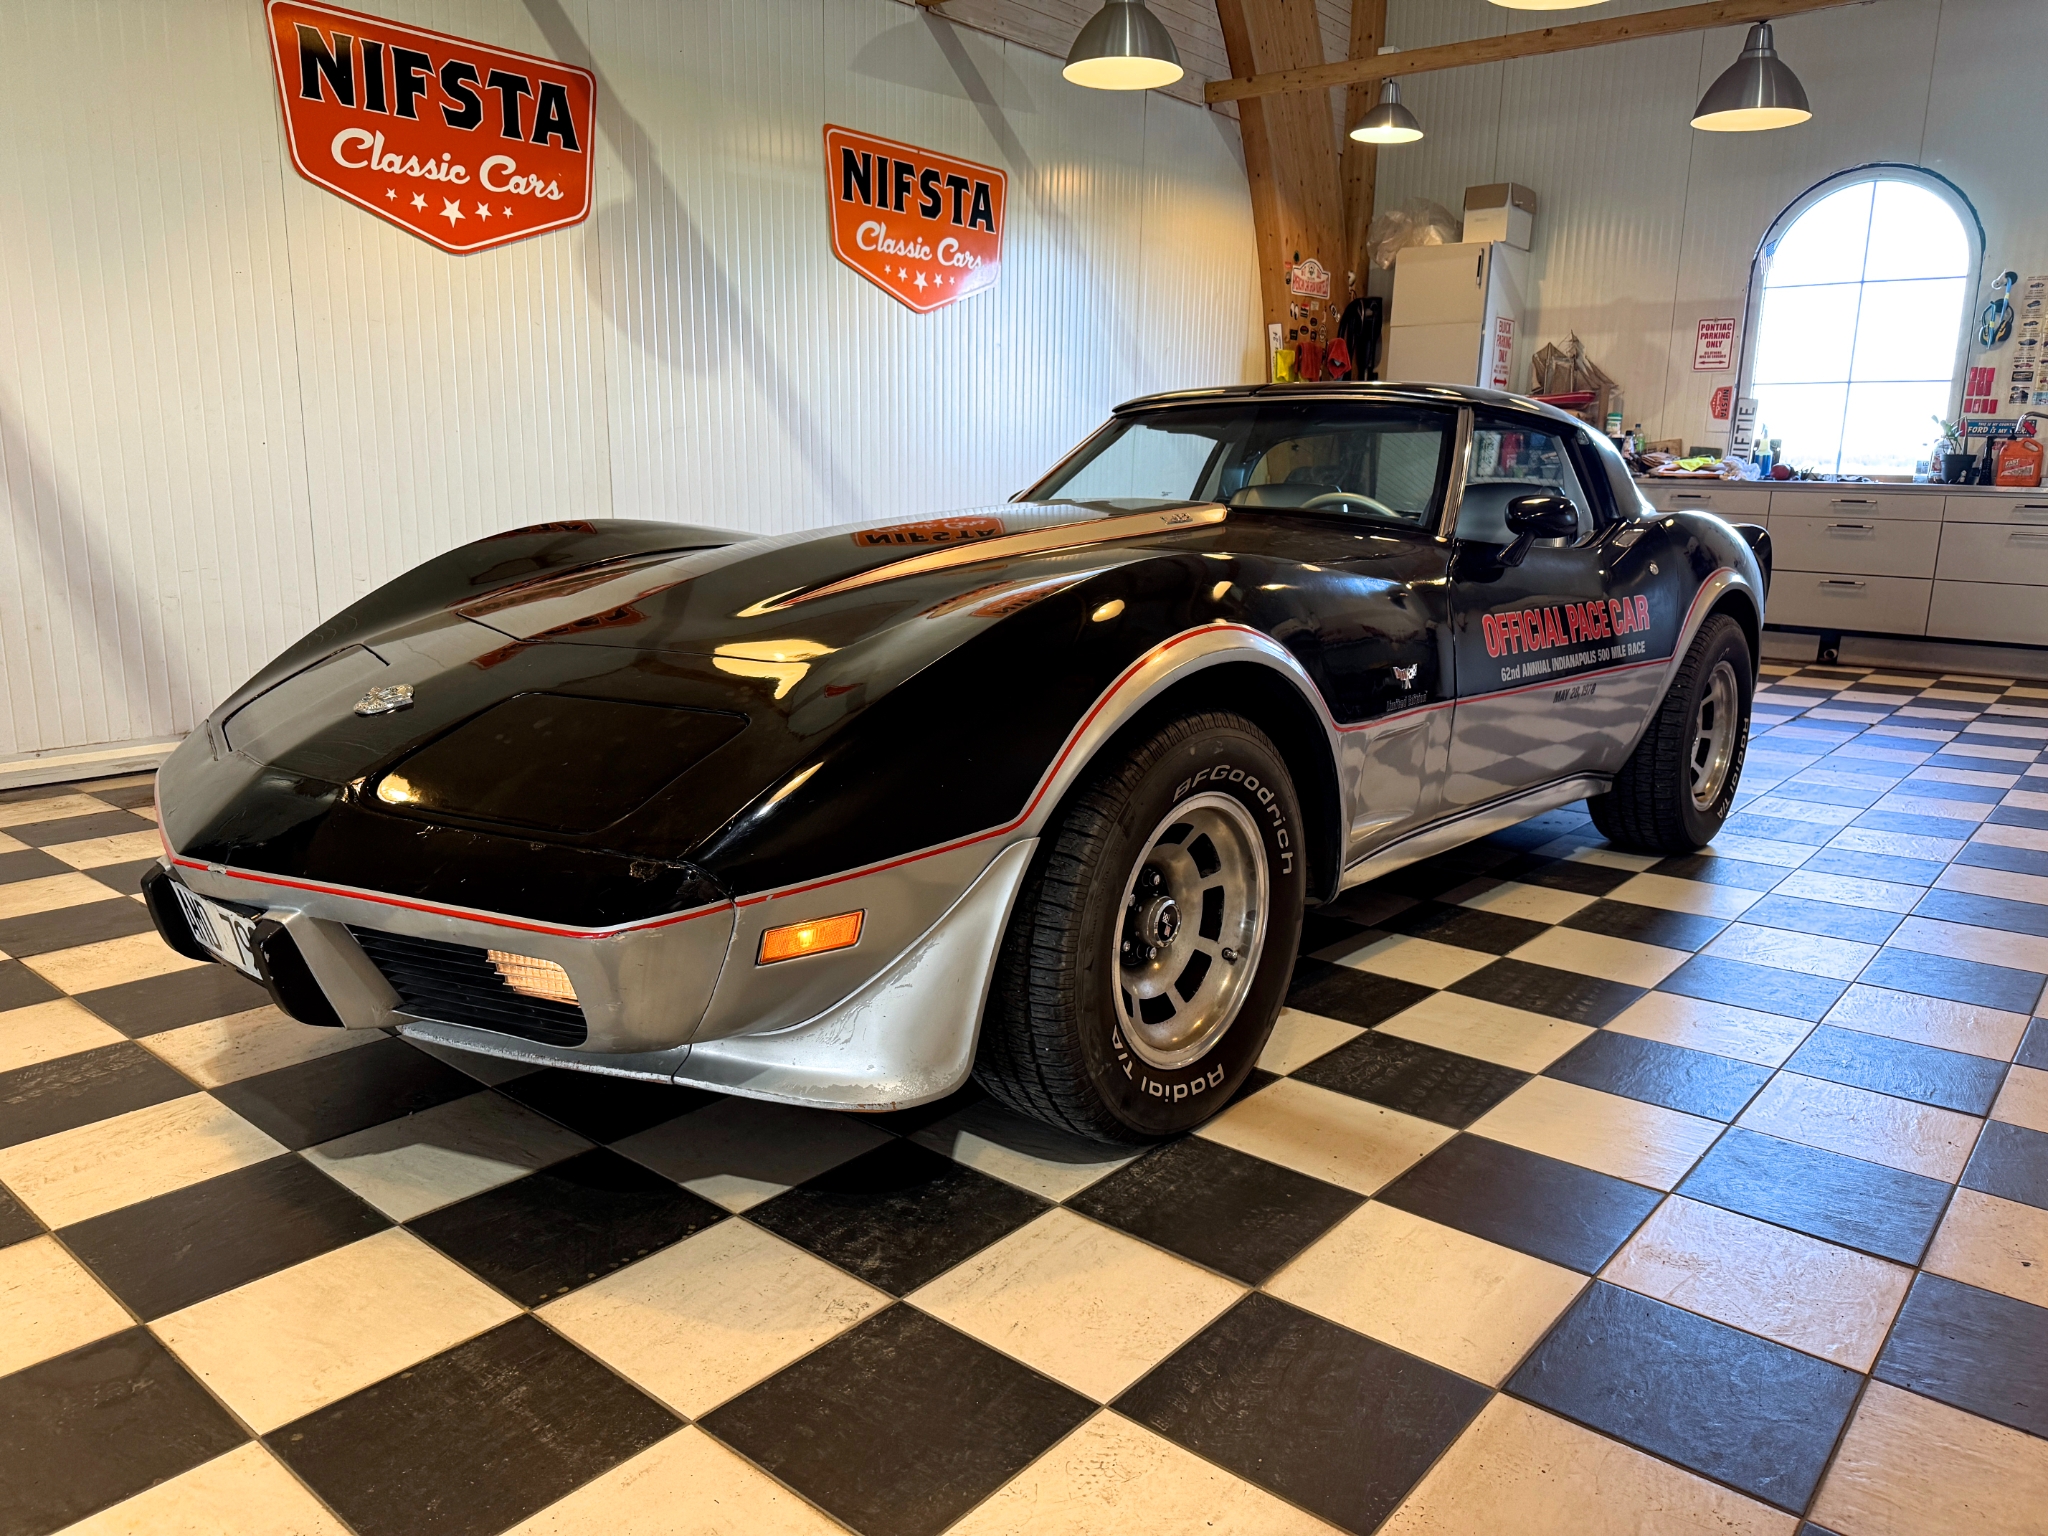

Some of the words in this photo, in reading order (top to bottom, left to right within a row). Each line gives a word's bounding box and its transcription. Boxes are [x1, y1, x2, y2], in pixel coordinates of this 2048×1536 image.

[293, 22, 582, 153] NIFSTA
[331, 128, 470, 184] Classic
[479, 155, 564, 200] Cars
[840, 146, 996, 234] NIFSTA
[856, 221, 932, 260] Classic
[937, 237, 984, 270] Cars
[1700, 332, 1731, 340] PARKING
[1701, 323, 1732, 331] PONTIAC
[1706, 340, 1723, 349] ONLY
[1721, 389, 1729, 417] NIFSTA
[1482, 606, 1569, 658] OFFICIAL
[1565, 600, 1611, 643] PACE
[1608, 594, 1650, 637] CAR
[1501, 666, 1521, 682] 62nd
[1522, 662, 1551, 678] ANNUAL
[1551, 650, 1597, 672] INDIANAPOLIS
[1598, 648, 1611, 662] 500
[1611, 644, 1626, 660] MILE
[1627, 641, 1645, 656] RACE
[1553, 688, 1571, 703] MAY
[1729, 717, 1749, 793] Radial
[1173, 764, 1294, 875] BFGoodrich
[1141, 1063, 1225, 1102] Radial
